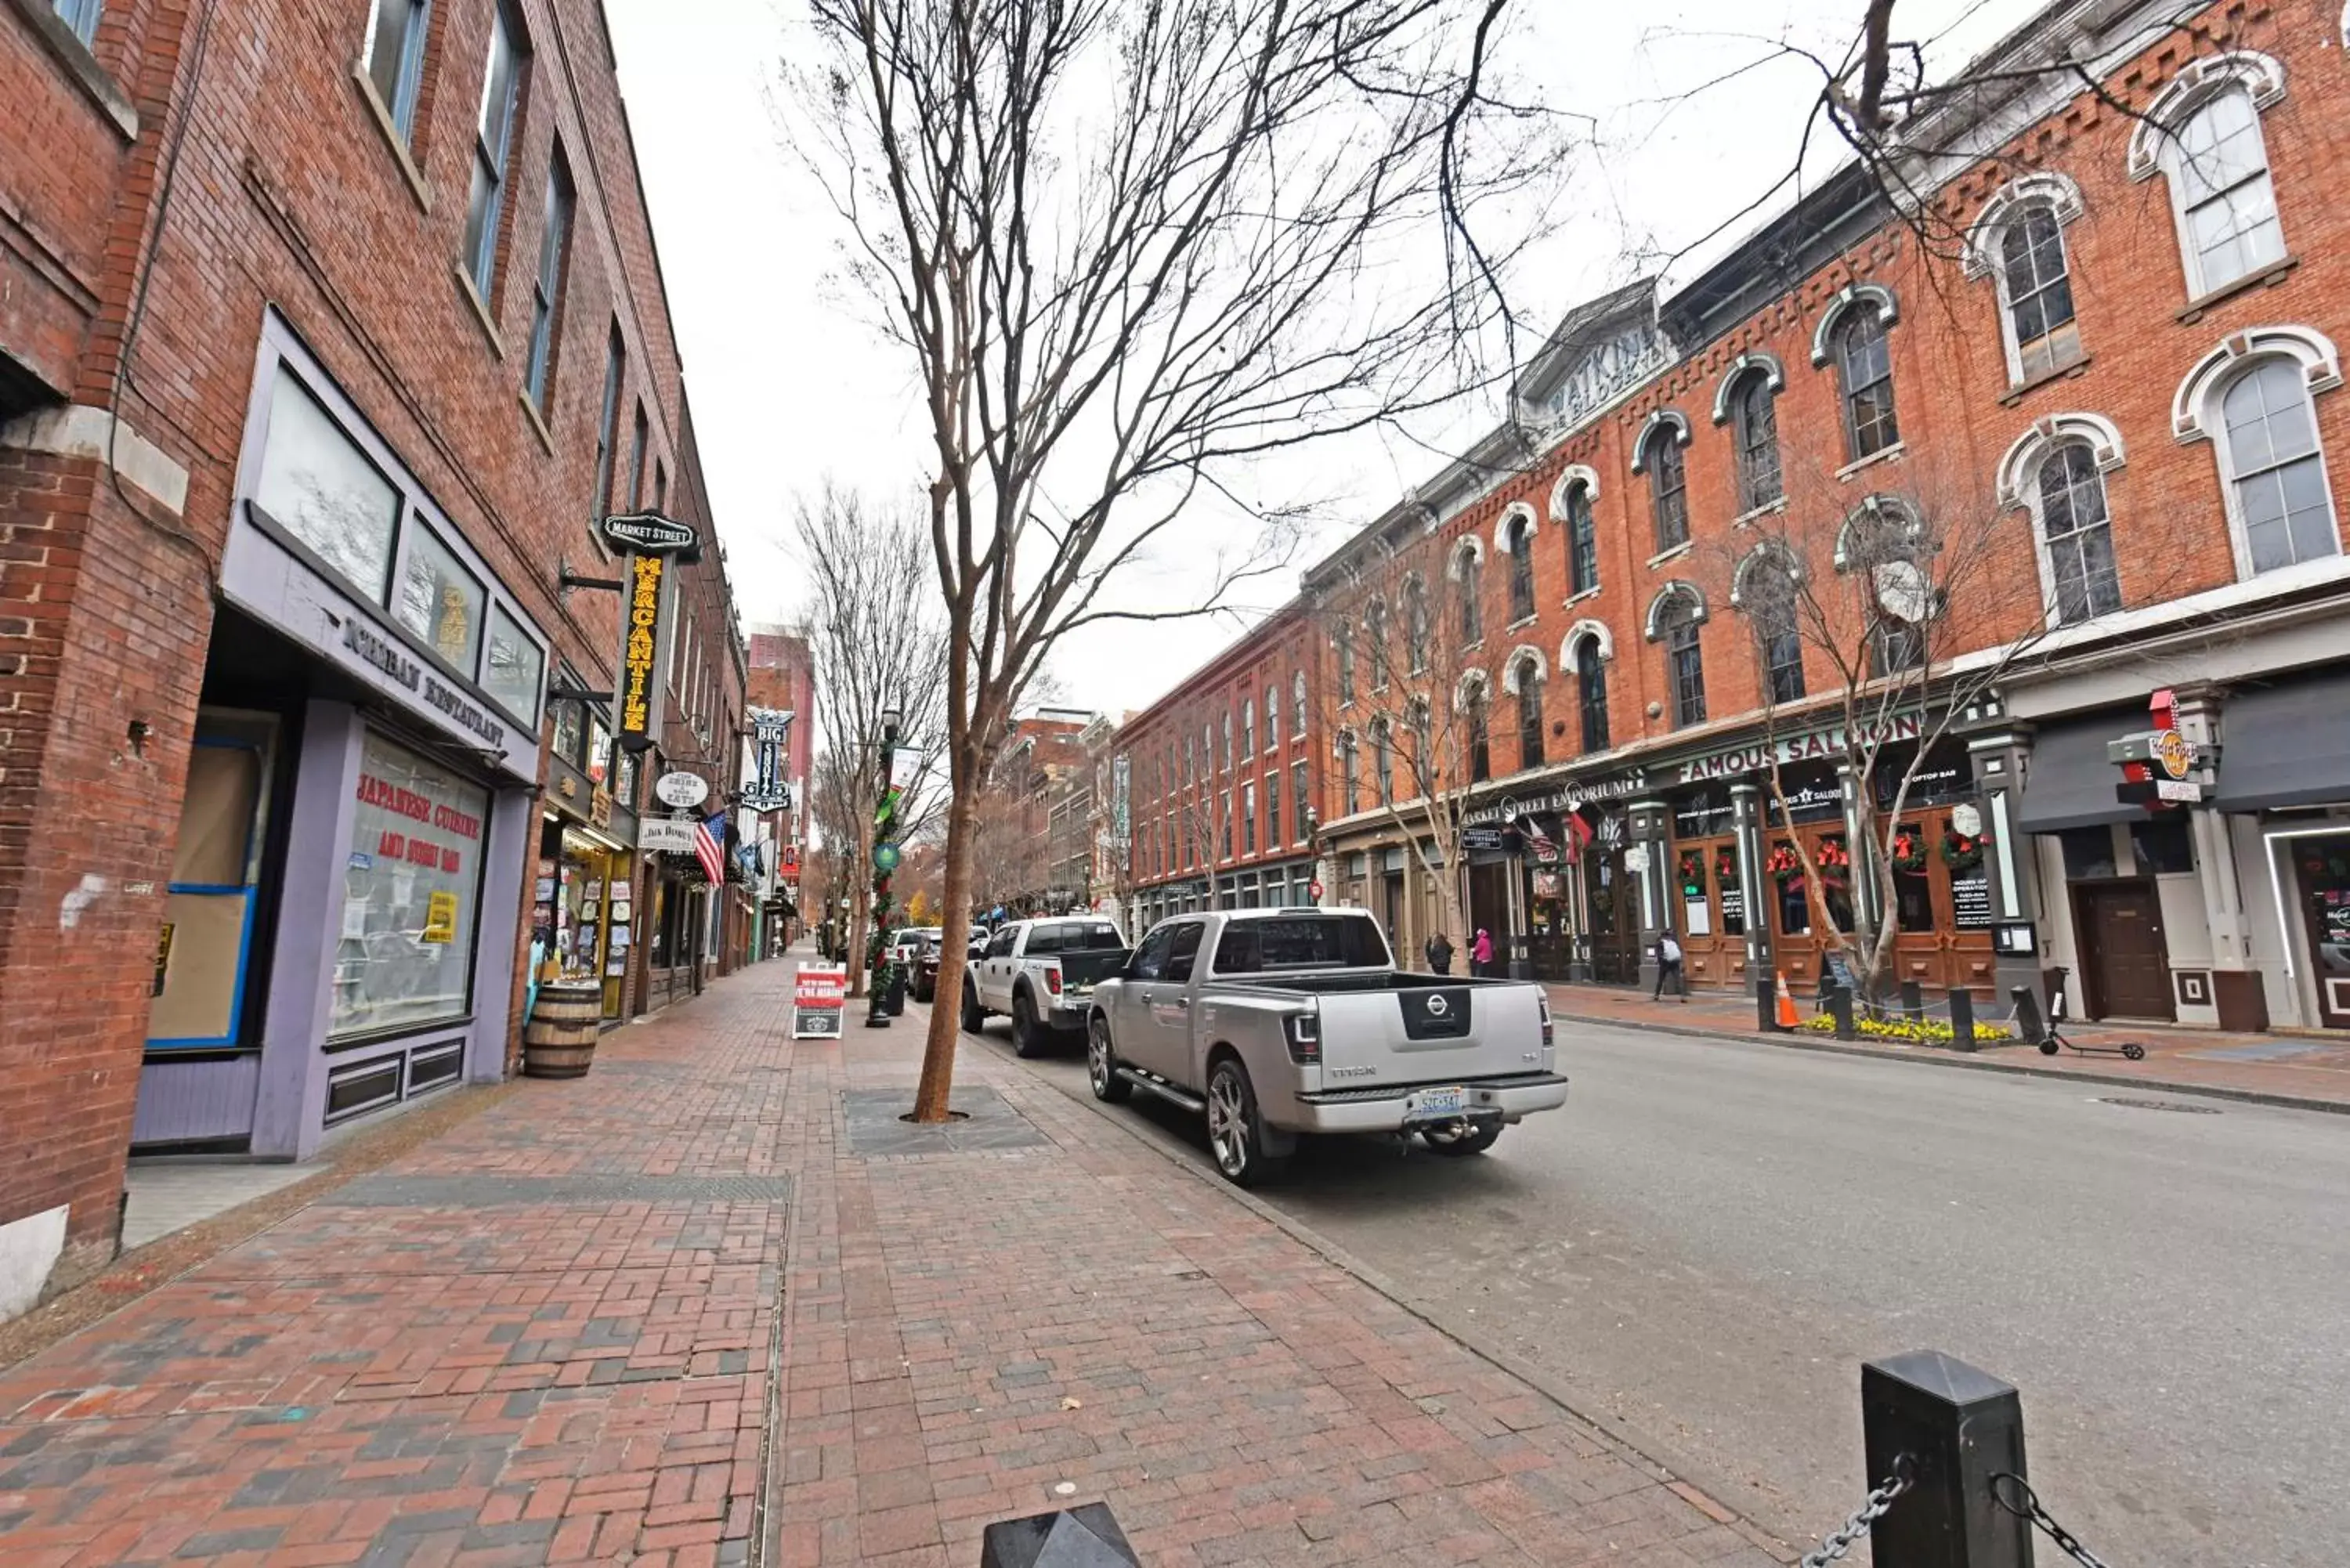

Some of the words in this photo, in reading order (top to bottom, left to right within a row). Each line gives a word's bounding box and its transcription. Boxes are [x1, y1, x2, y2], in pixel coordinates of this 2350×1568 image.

[613, 522, 652, 538] MARKET
[653, 528, 688, 543] STREET
[624, 555, 663, 732] MERCANTILE
[424, 676, 504, 748] RESTAURANT
[757, 727, 782, 740] BIG
[1679, 747, 1780, 783] FAMOUS
[1788, 714, 1919, 760] SALOON
[357, 773, 431, 822] JAPANESE
[435, 804, 480, 840] CUISINE
[1552, 780, 1627, 808] EMPORIUM
[378, 829, 404, 859] AND
[1331, 1065, 1377, 1078] TITAN
